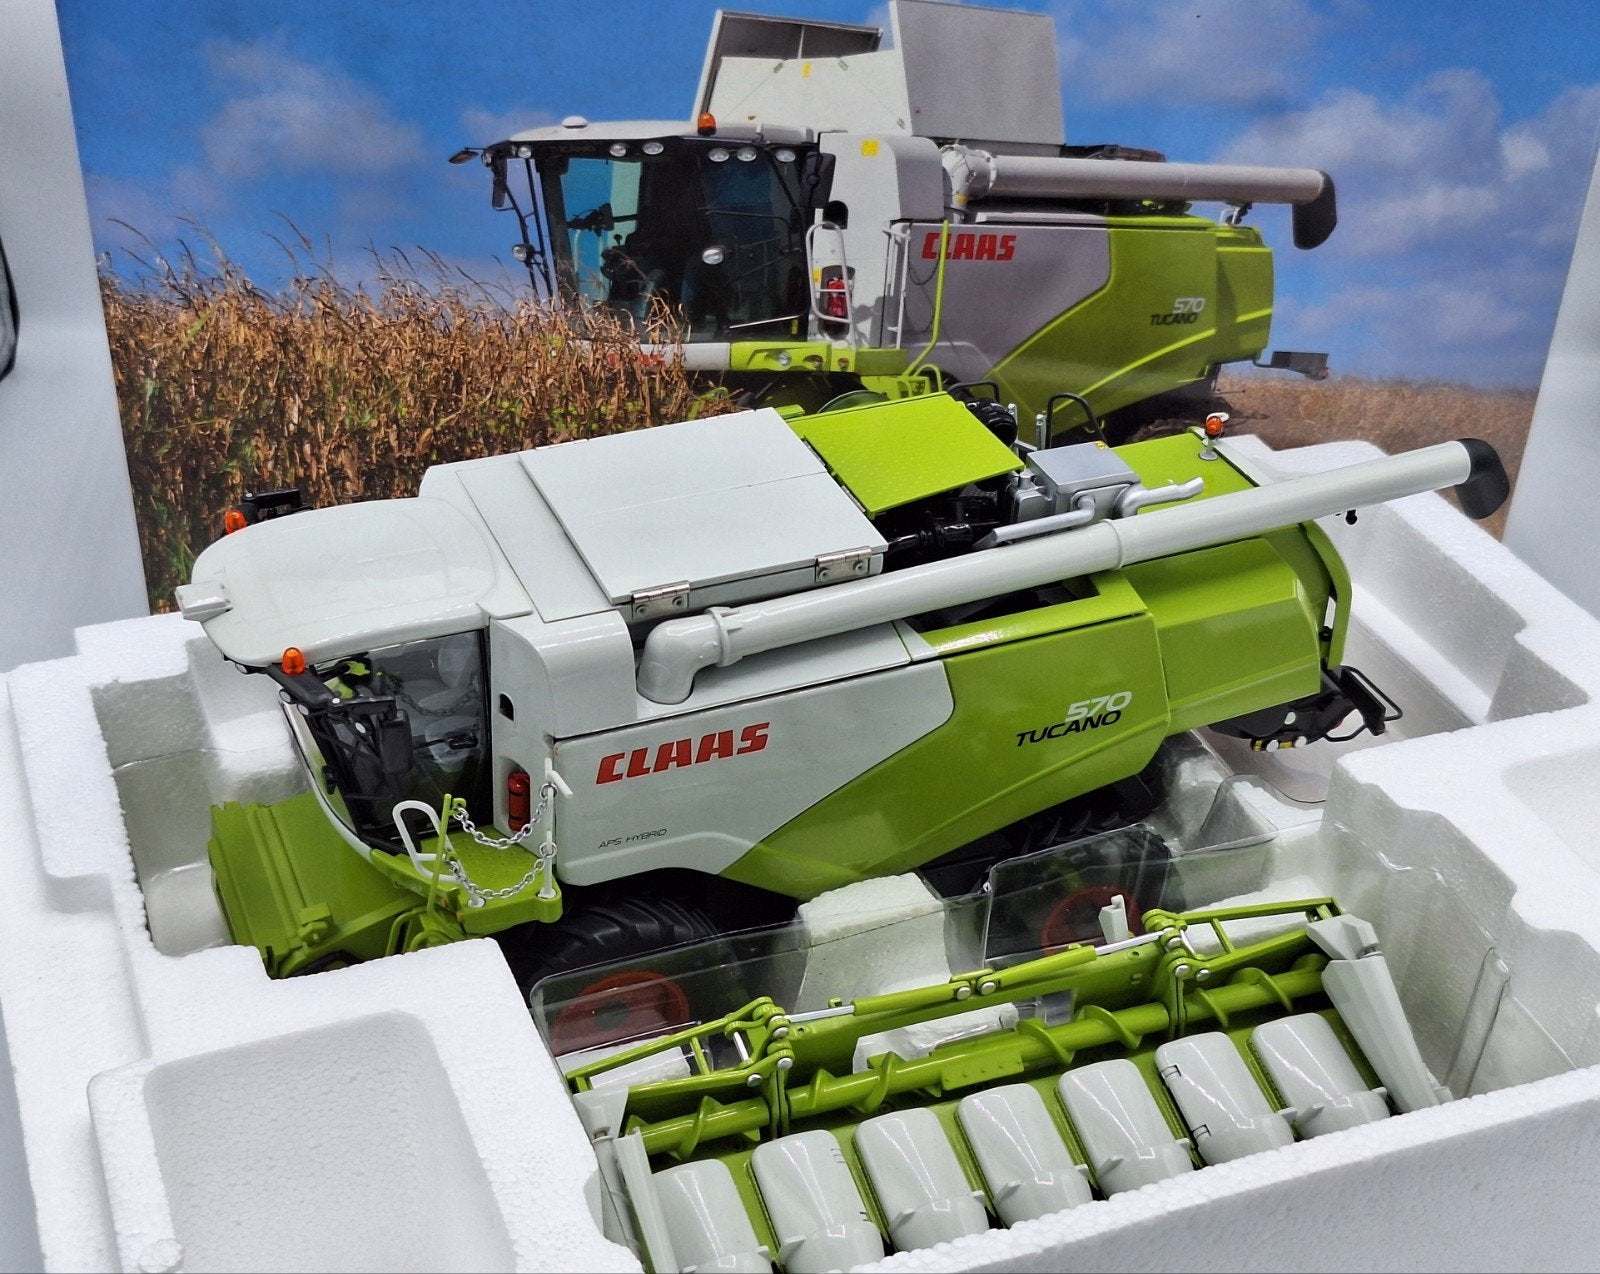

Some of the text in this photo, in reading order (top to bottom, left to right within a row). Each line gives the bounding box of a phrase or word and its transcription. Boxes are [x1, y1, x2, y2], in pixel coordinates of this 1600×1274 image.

[1172, 297, 1206, 314] 570
[1151, 312, 1198, 326] TUCANO
[1065, 691, 1132, 722] 570
[1016, 710, 1122, 747] TUCANO
[595, 721, 770, 785] CLAAS
[598, 828, 668, 849] APS HYBRID
